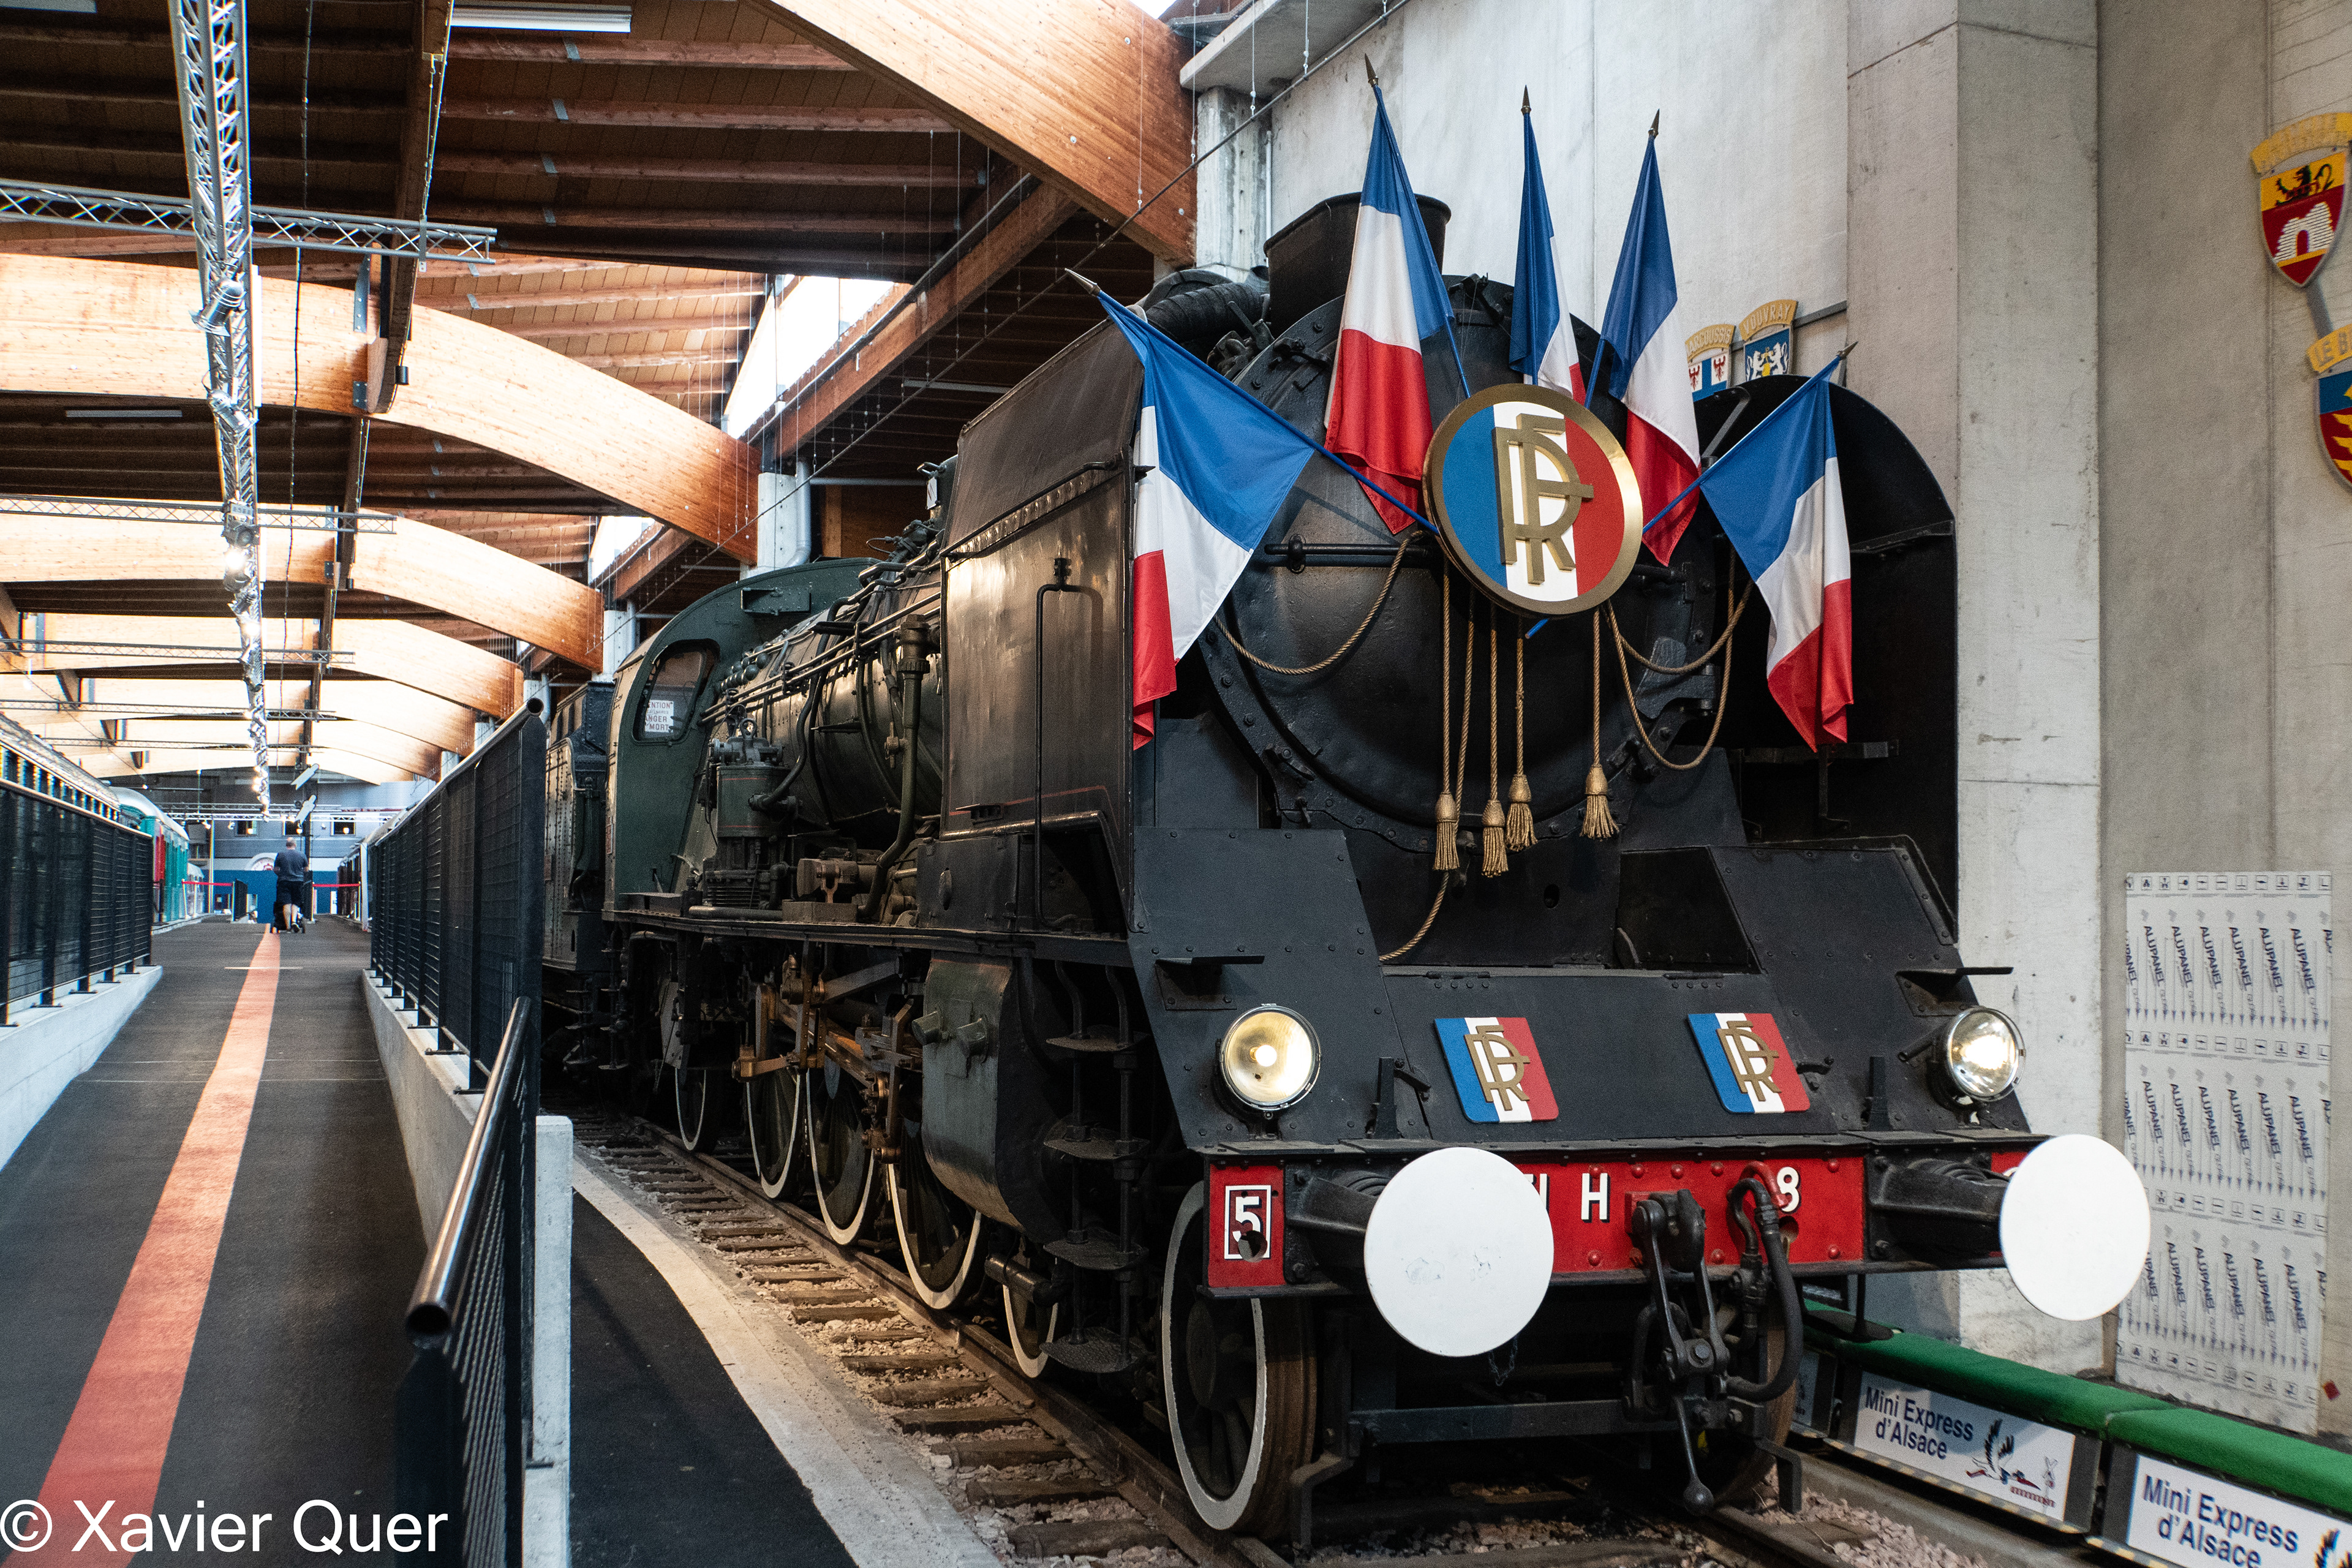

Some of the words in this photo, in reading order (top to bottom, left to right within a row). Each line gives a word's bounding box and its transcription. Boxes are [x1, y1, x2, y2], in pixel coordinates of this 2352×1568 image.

[1743, 304, 1791, 334] VOUVRAY
[2315, 341, 2334, 366] LE
[2339, 329, 2352, 355] B
[2144, 926, 2165, 987] ALUPANEL
[2171, 926, 2193, 988] ALUPANEL
[2199, 926, 2223, 989] ALUPANEL
[2228, 927, 2252, 991] ALUPANEL
[2259, 927, 2283, 993] ALUPANEL
[2290, 929, 2315, 995] ALUPANEL
[2143, 1081, 2163, 1144] ALUPANEL
[2170, 1084, 2191, 1147] ALUPANEL
[2199, 1086, 2220, 1151] ALUPANEL
[2227, 1089, 2250, 1155] ALUPANEL
[2258, 1092, 2281, 1159] ALUPANEL
[2288, 1095, 2313, 1163] ALUPANEL
[1232, 1196, 1262, 1243] 5
[1581, 1173, 1610, 1223] H
[1777, 1166, 1801, 1214] 8
[2165, 1241, 2186, 1307] ALUPANEL
[2193, 1246, 2215, 1314] ALUPANEL
[2223, 1252, 2245, 1320] ALUPANEL
[2252, 1257, 2275, 1327] ALUPANEL
[2284, 1264, 2307, 1333] ALUPANEL
[1866, 1387, 1899, 1417] Mini
[1904, 1399, 1973, 1441] Express
[1875, 1417, 1947, 1460] d'Alsace
[2143, 1474, 2192, 1515] Mini
[2198, 1492, 2299, 1553] Express
[2157, 1512, 2261, 1568] d'Alsace
